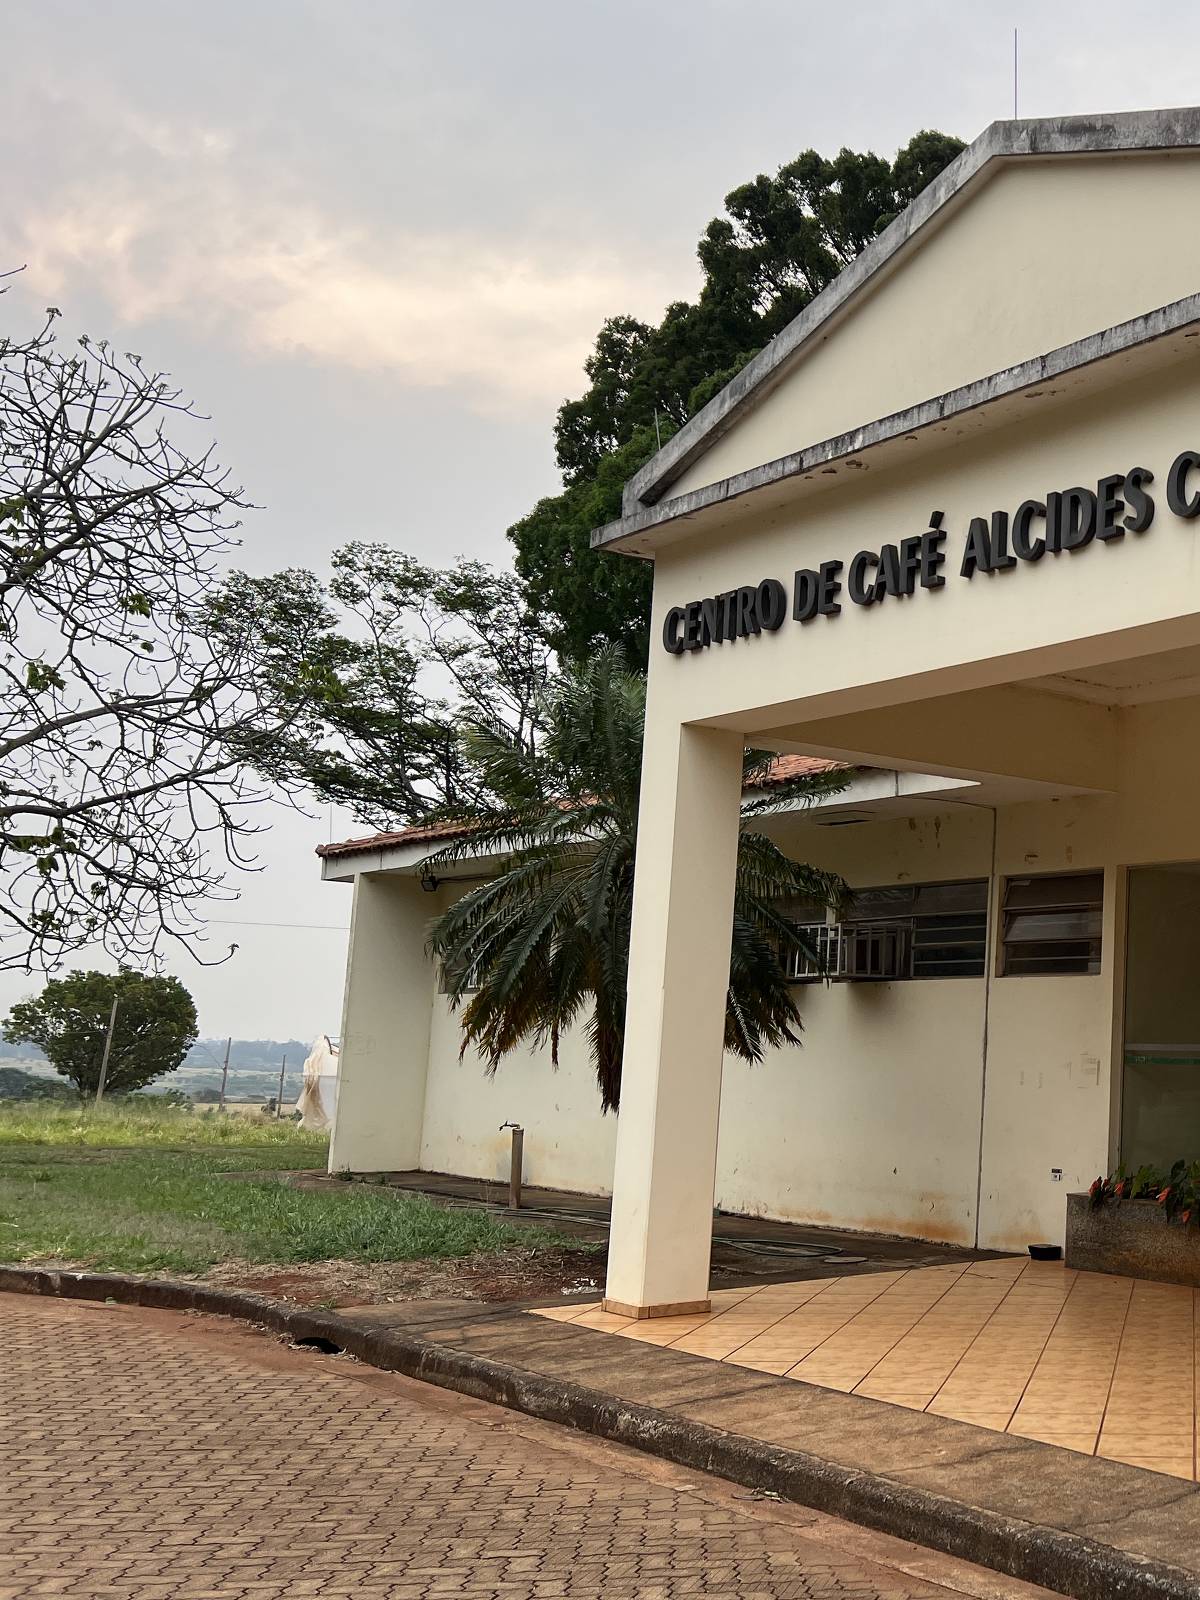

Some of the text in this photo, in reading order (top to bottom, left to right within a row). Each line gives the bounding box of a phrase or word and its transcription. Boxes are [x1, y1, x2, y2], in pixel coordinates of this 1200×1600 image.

[663, 577, 787, 655] CENTRO
[793, 559, 844, 622] DE
[848, 510, 946, 606] CAFÉ
[959, 466, 1155, 578] ALCIDES
